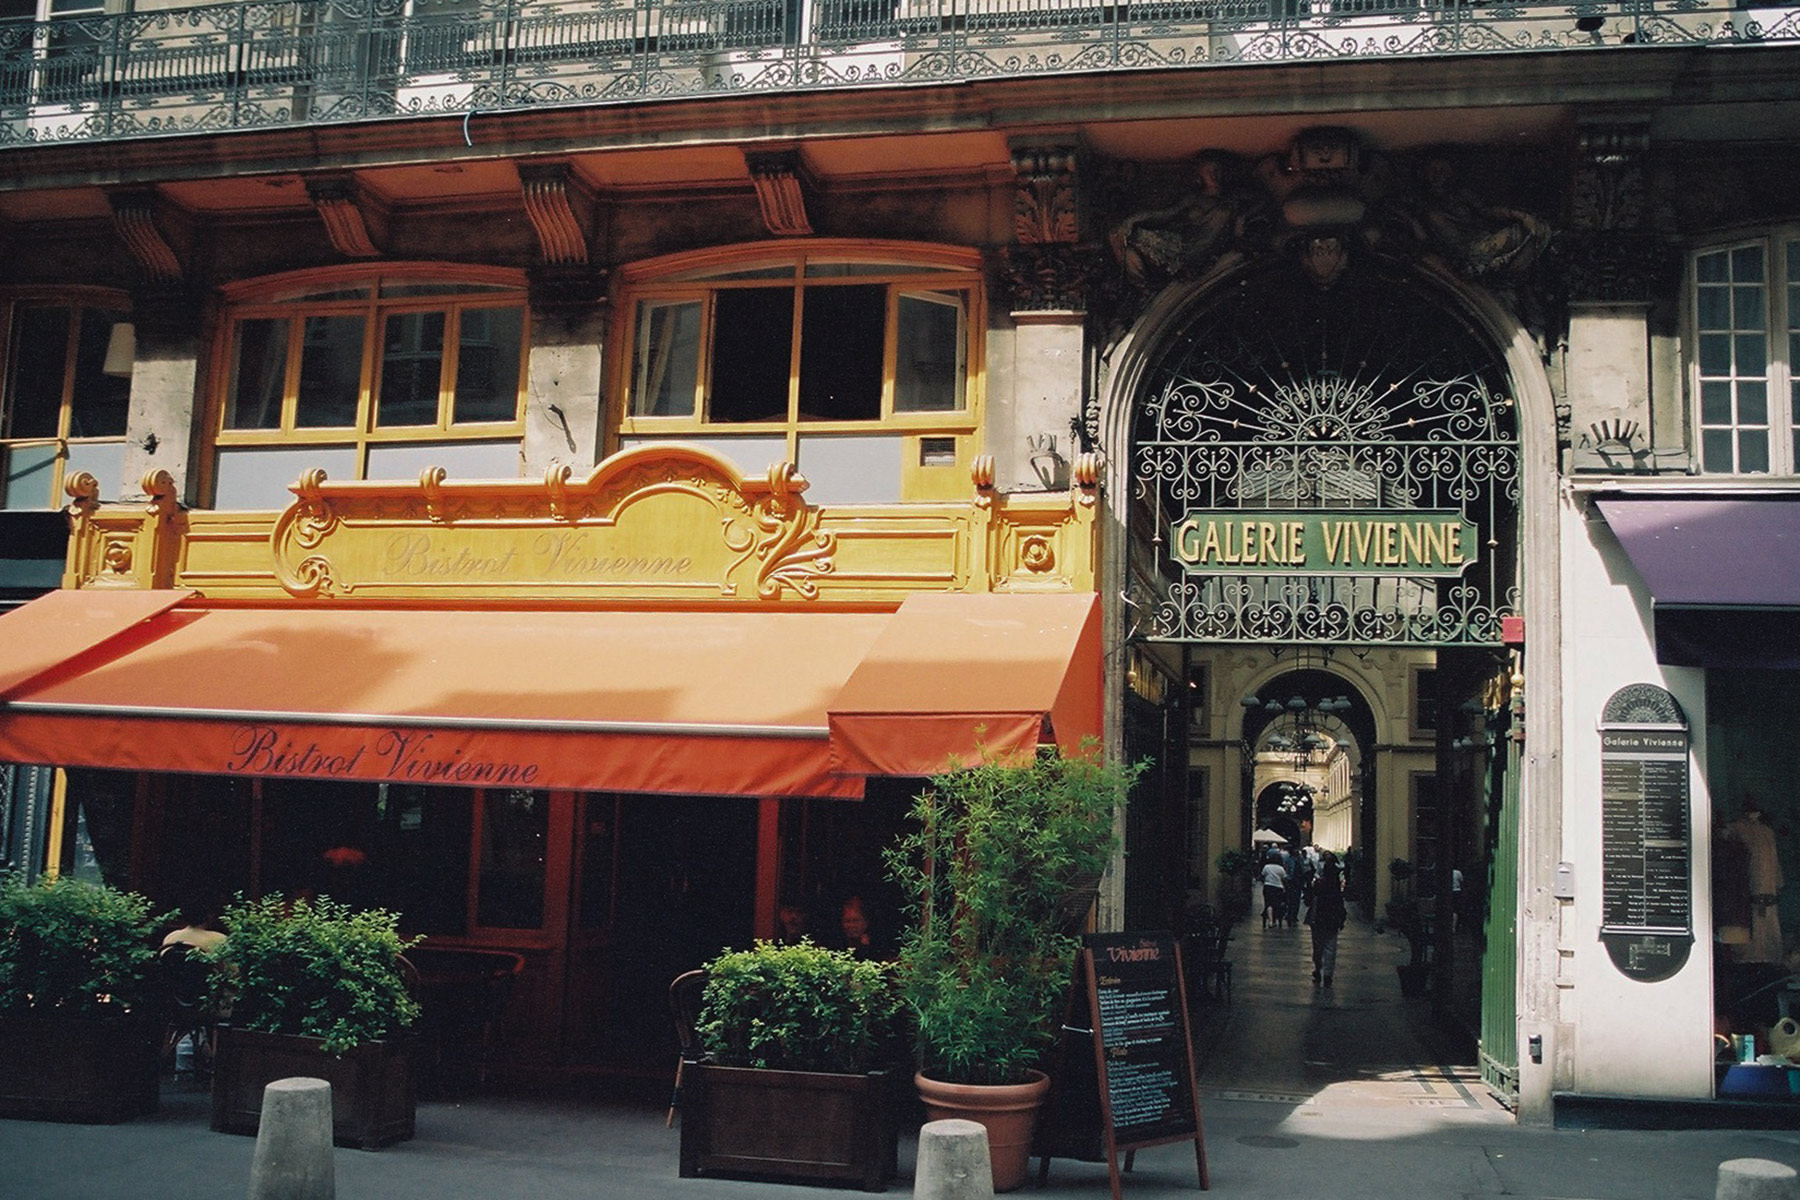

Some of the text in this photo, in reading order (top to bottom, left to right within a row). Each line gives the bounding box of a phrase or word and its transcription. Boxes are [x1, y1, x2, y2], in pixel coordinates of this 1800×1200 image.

[382, 530, 693, 577] Bistrot Vivienne
[1178, 520, 1465, 567] GALERIE VIVIENNE
[227, 725, 541, 785] Bistrot Vivienne
[1603, 737, 1684, 747] Galerie Vivienne
[1106, 945, 1160, 962] Vivienne
